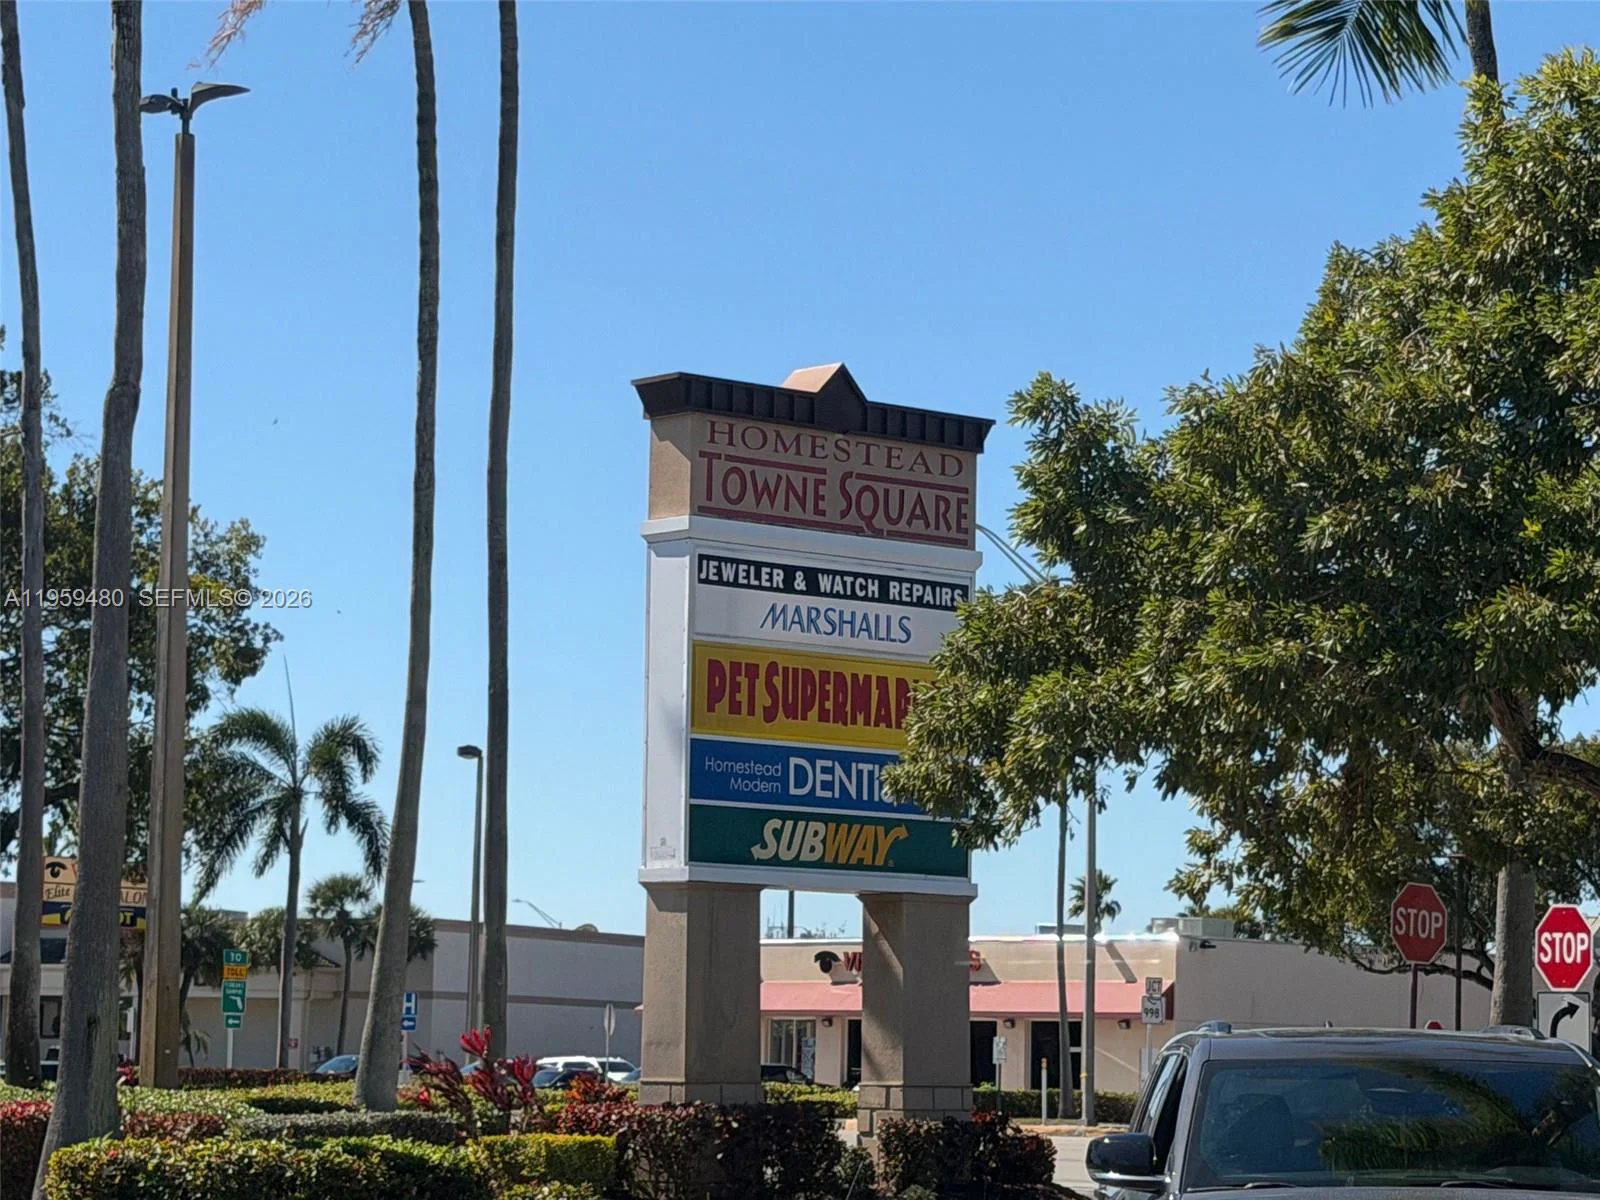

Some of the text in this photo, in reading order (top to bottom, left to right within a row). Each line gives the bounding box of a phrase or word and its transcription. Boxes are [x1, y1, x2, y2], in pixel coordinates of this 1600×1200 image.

[706, 420, 964, 478] HOMESTEAD
[698, 450, 969, 537] TOWNE SQUARE
[700, 560, 963, 607] JEWELER & WATCH REPAIRS
[760, 603, 912, 643] MARSHALLS
[706, 658, 924, 731] PET SUPERMAR
[705, 757, 782, 776] Homestead
[729, 776, 782, 794] Modern
[751, 818, 909, 867] SUBWAY
[45, 885, 71, 899] Elite
[1395, 907, 1443, 940] STOP
[230, 951, 242, 962] TO
[1539, 931, 1589, 965] STOP
[402, 992, 416, 1015] H
[1143, 1007, 1161, 1019] 998
